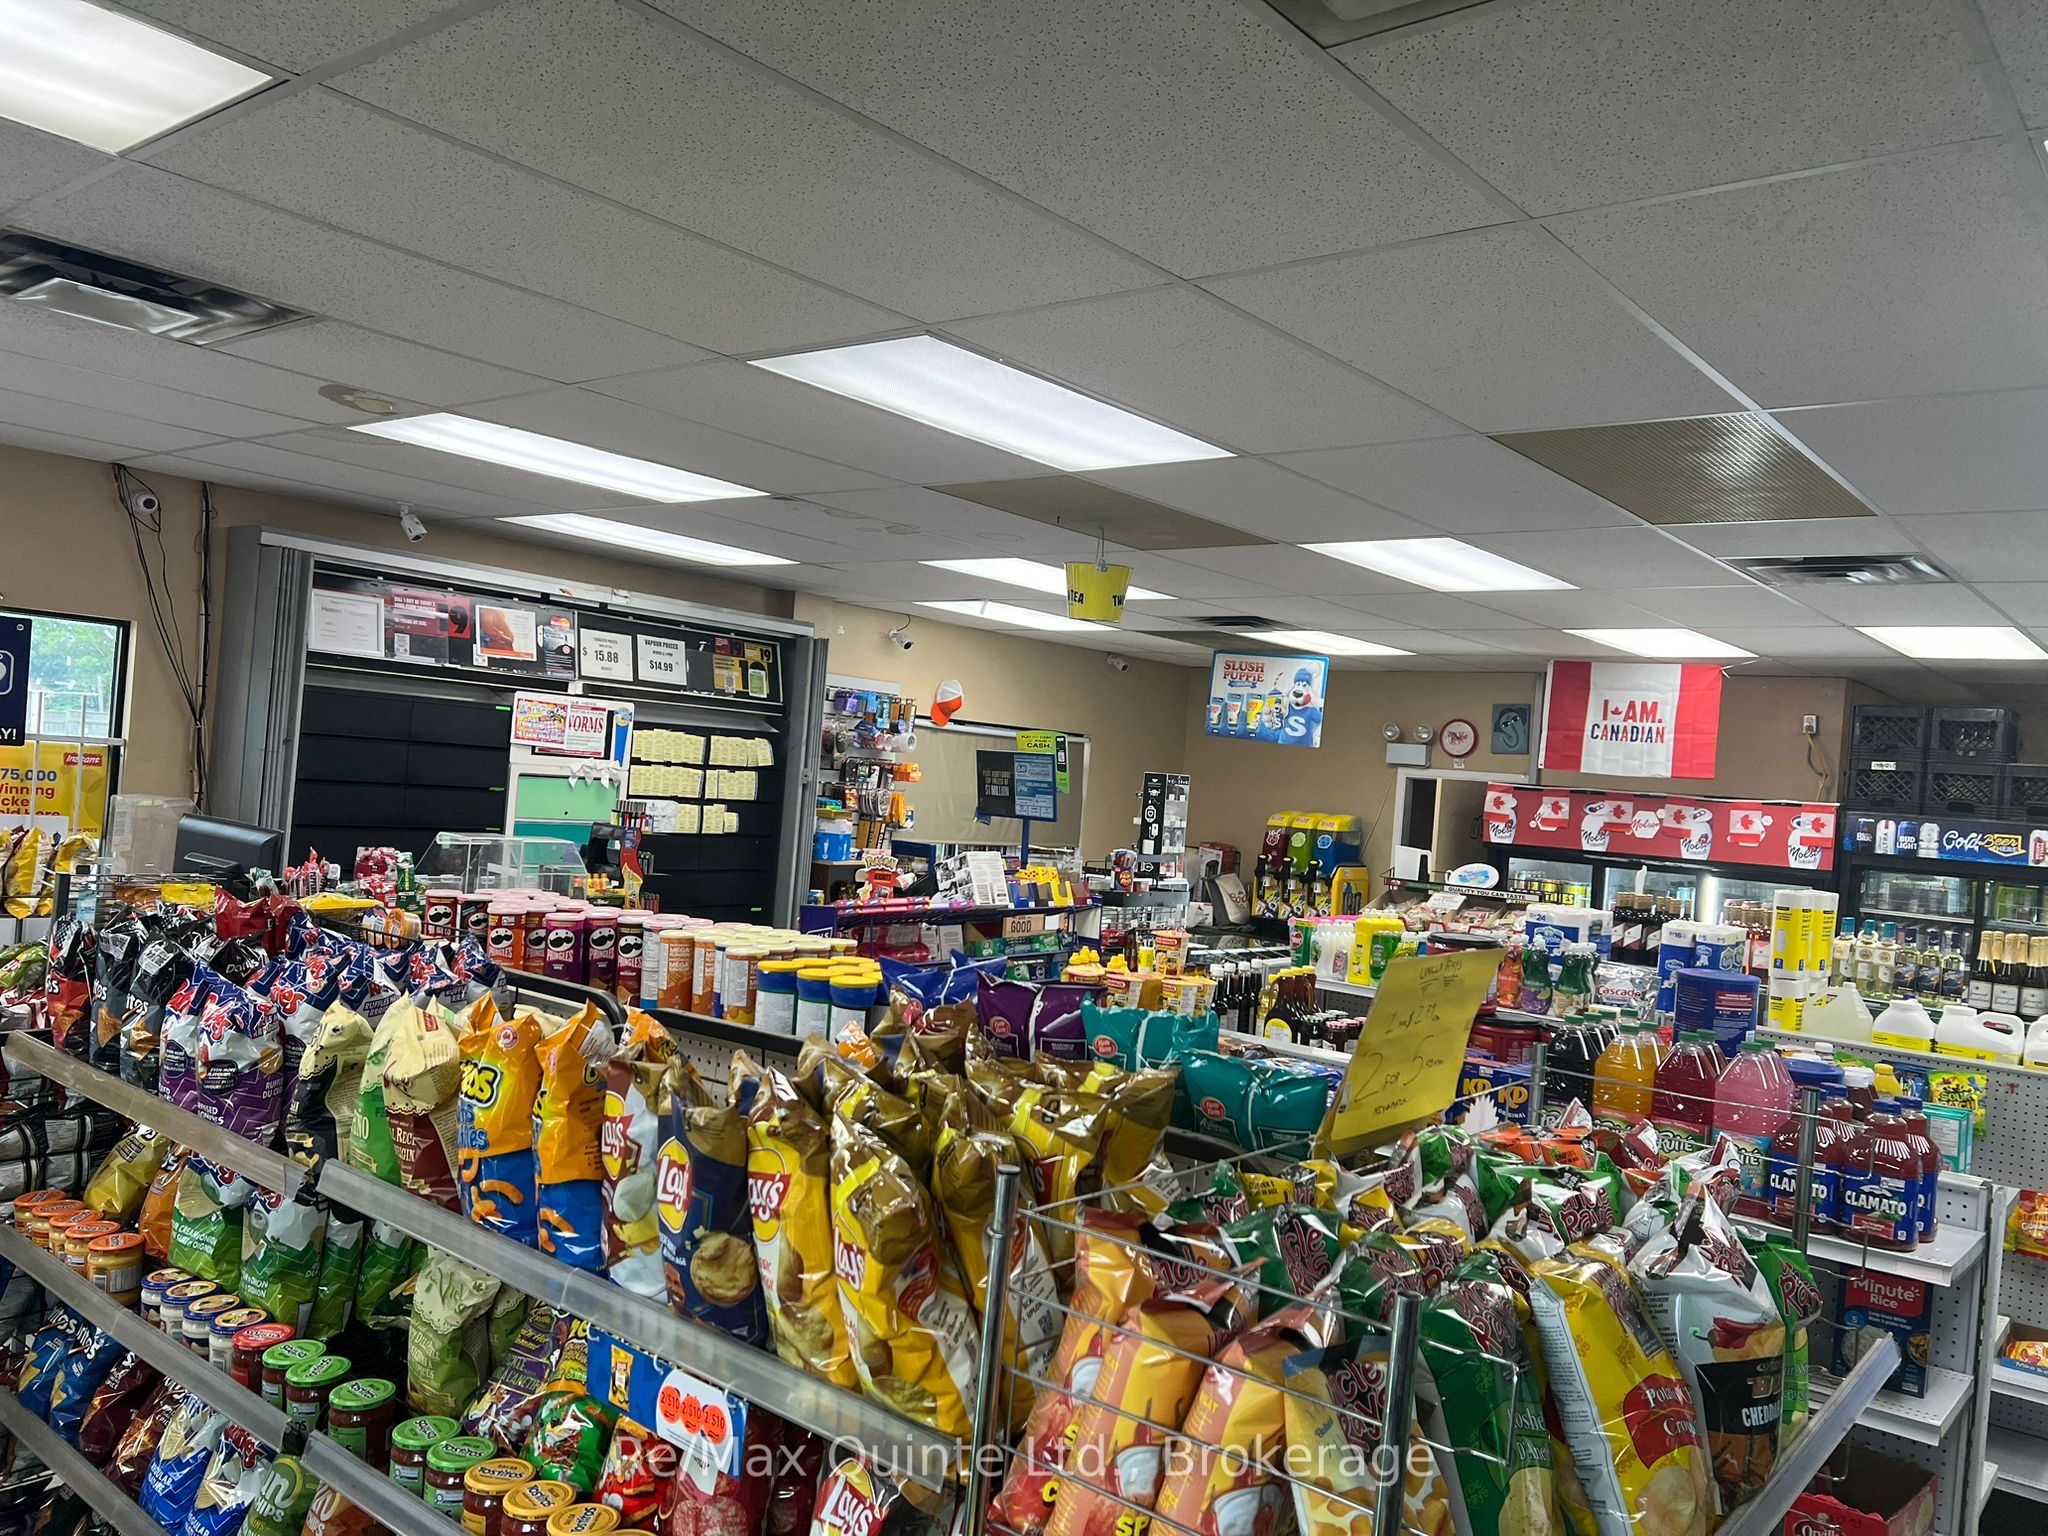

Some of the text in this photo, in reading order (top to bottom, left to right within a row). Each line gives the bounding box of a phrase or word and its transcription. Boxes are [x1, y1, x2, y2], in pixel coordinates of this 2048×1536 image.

[644, 639, 678, 650] VAPOUR PRICES
[594, 649, 619, 663] 15.88
[649, 659, 673, 672] $14.99
[1223, 660, 1264, 673] SLUSH
[1590, 723, 1665, 743] CANADIAN
[1896, 842, 1917, 850] LIGHT
[1899, 836, 1915, 844] BUD
[1943, 830, 2018, 853] Cold Beer
[1448, 887, 1474, 896] QUALITY
[1010, 919, 1032, 934] GOOD
[546, 949, 574, 962] PRINGLES
[617, 956, 642, 968] PRINGLES
[1598, 986, 1642, 998] Cascade
[1462, 1078, 1492, 1095] KD
[1498, 1086, 1528, 1107] KD
[1940, 1092, 1971, 1101] SOUR
[1845, 1190, 1907, 1216] CLAMATO
[834, 1227, 865, 1291] Lay's
[1853, 1275, 1915, 1302] Minute
[1869, 1292, 1898, 1309] Rice
[660, 1391, 680, 1410] 2/$10
[704, 1411, 725, 1432] 2/$10
[441, 1442, 484, 1458] Tostitos
[478, 1465, 525, 1479] Tostitos
[527, 1484, 556, 1509] Tostitos
[820, 1473, 873, 1536] Lay's
[570, 1506, 598, 1534] Tostitos
